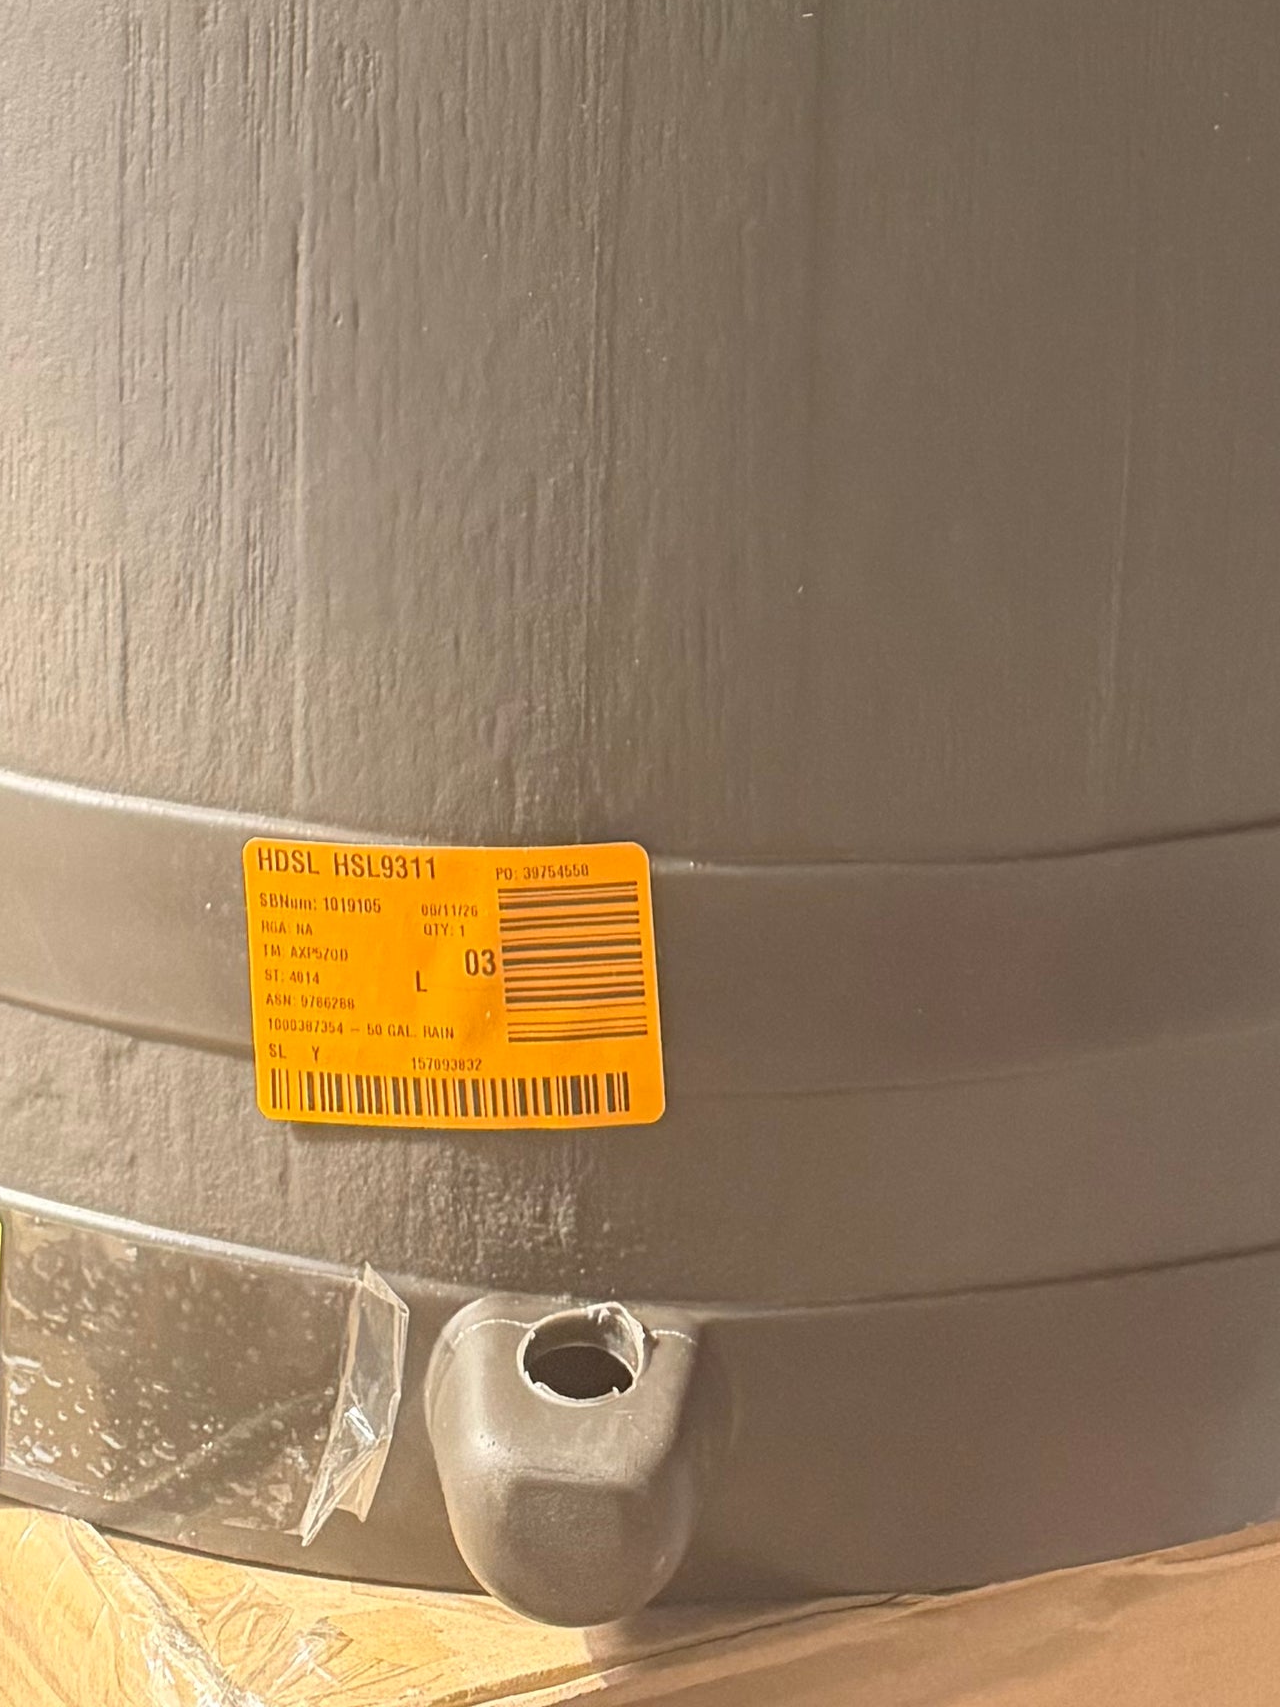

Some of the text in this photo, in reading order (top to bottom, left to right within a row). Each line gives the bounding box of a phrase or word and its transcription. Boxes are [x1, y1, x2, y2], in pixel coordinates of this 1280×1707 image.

[258, 848, 436, 879] HDSL HSL9311
[496, 867, 518, 880] PO:
[260, 893, 381, 914] SBNum: 1019105
[423, 924, 465, 937] QTY: 1
[465, 948, 496, 976] 03
[416, 970, 428, 992] L
[423, 1025, 454, 1039] RAIN
[269, 1043, 320, 1063] SL Y
